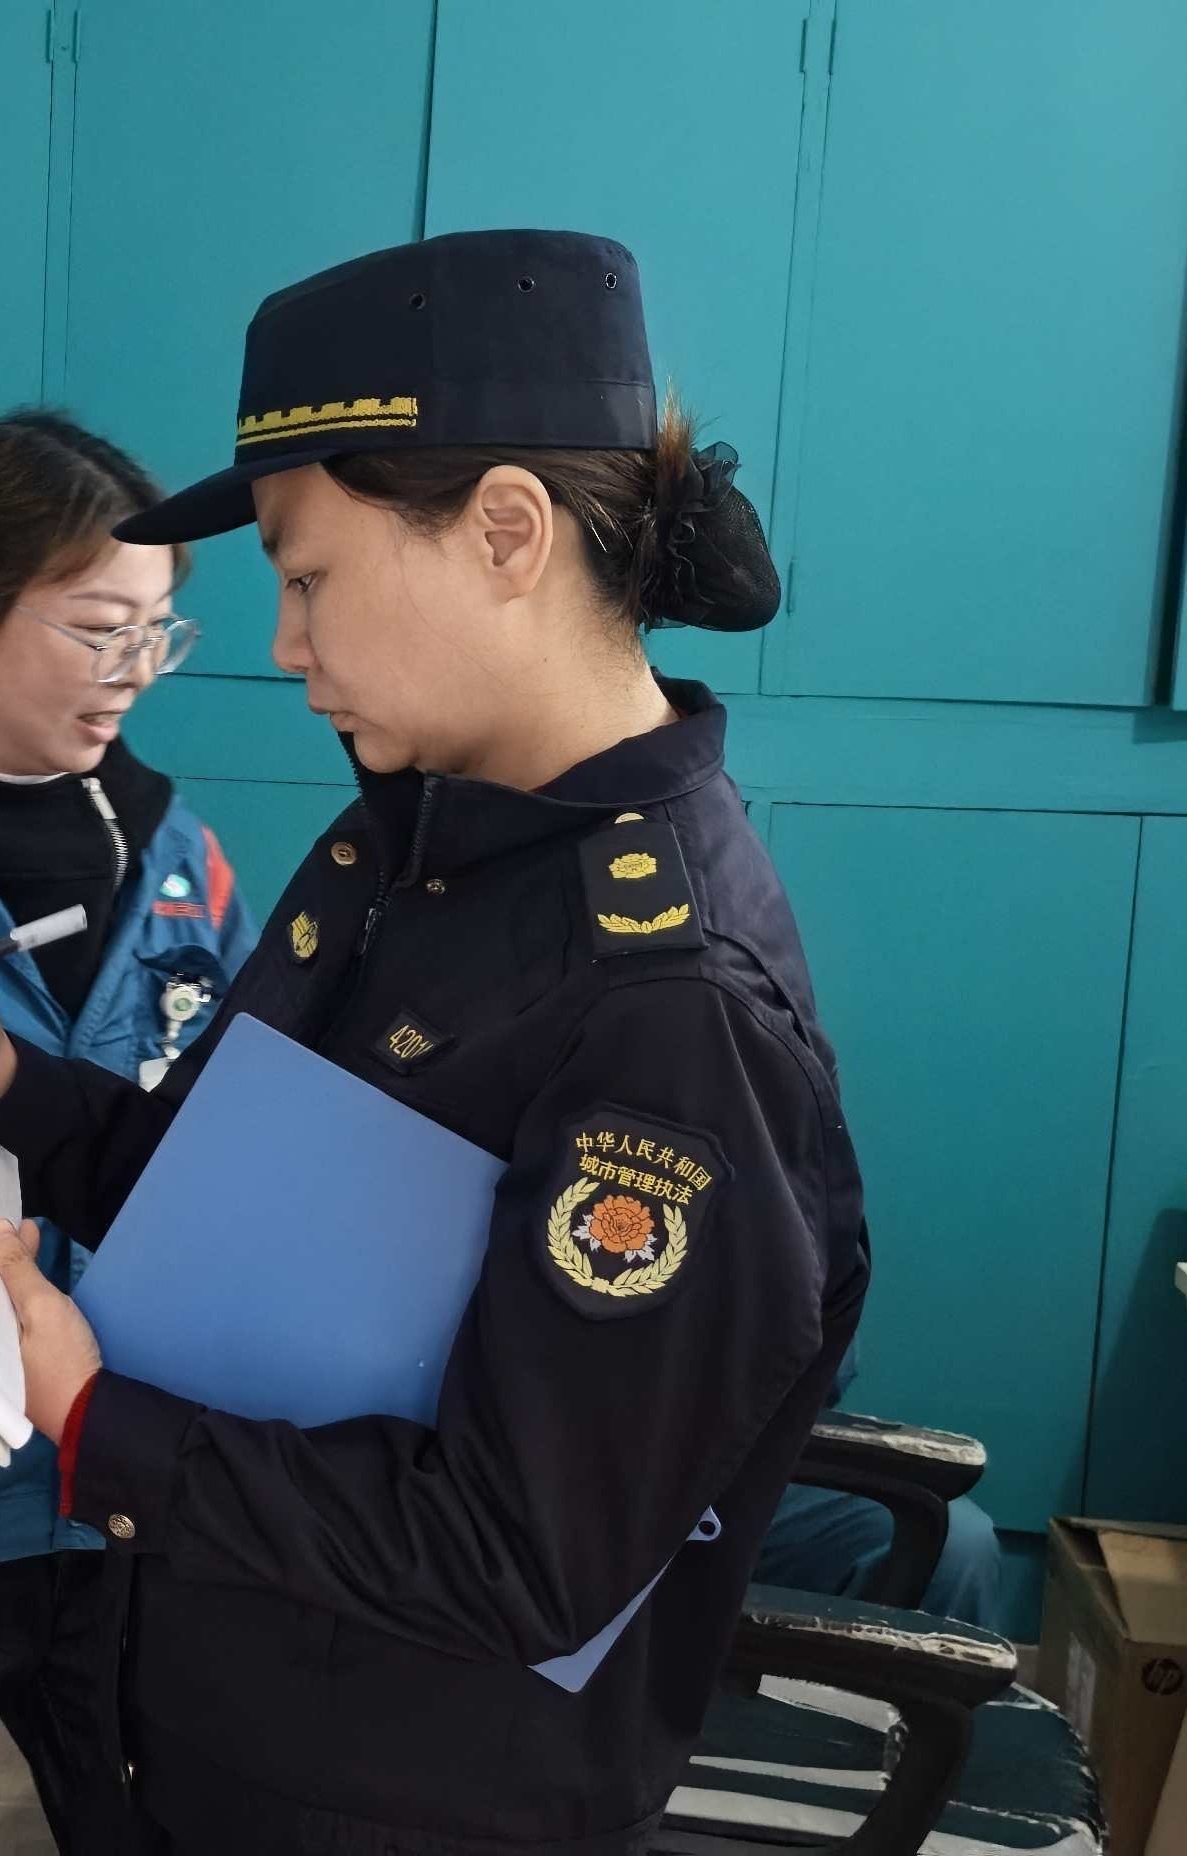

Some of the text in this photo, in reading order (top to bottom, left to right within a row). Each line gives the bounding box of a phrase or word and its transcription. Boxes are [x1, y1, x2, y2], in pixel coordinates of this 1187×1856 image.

[575, 1131, 713, 1191] 中华人民共和国
[579, 1153, 694, 1205] 城市管理执法
[1147, 1658, 1180, 1696] hp
